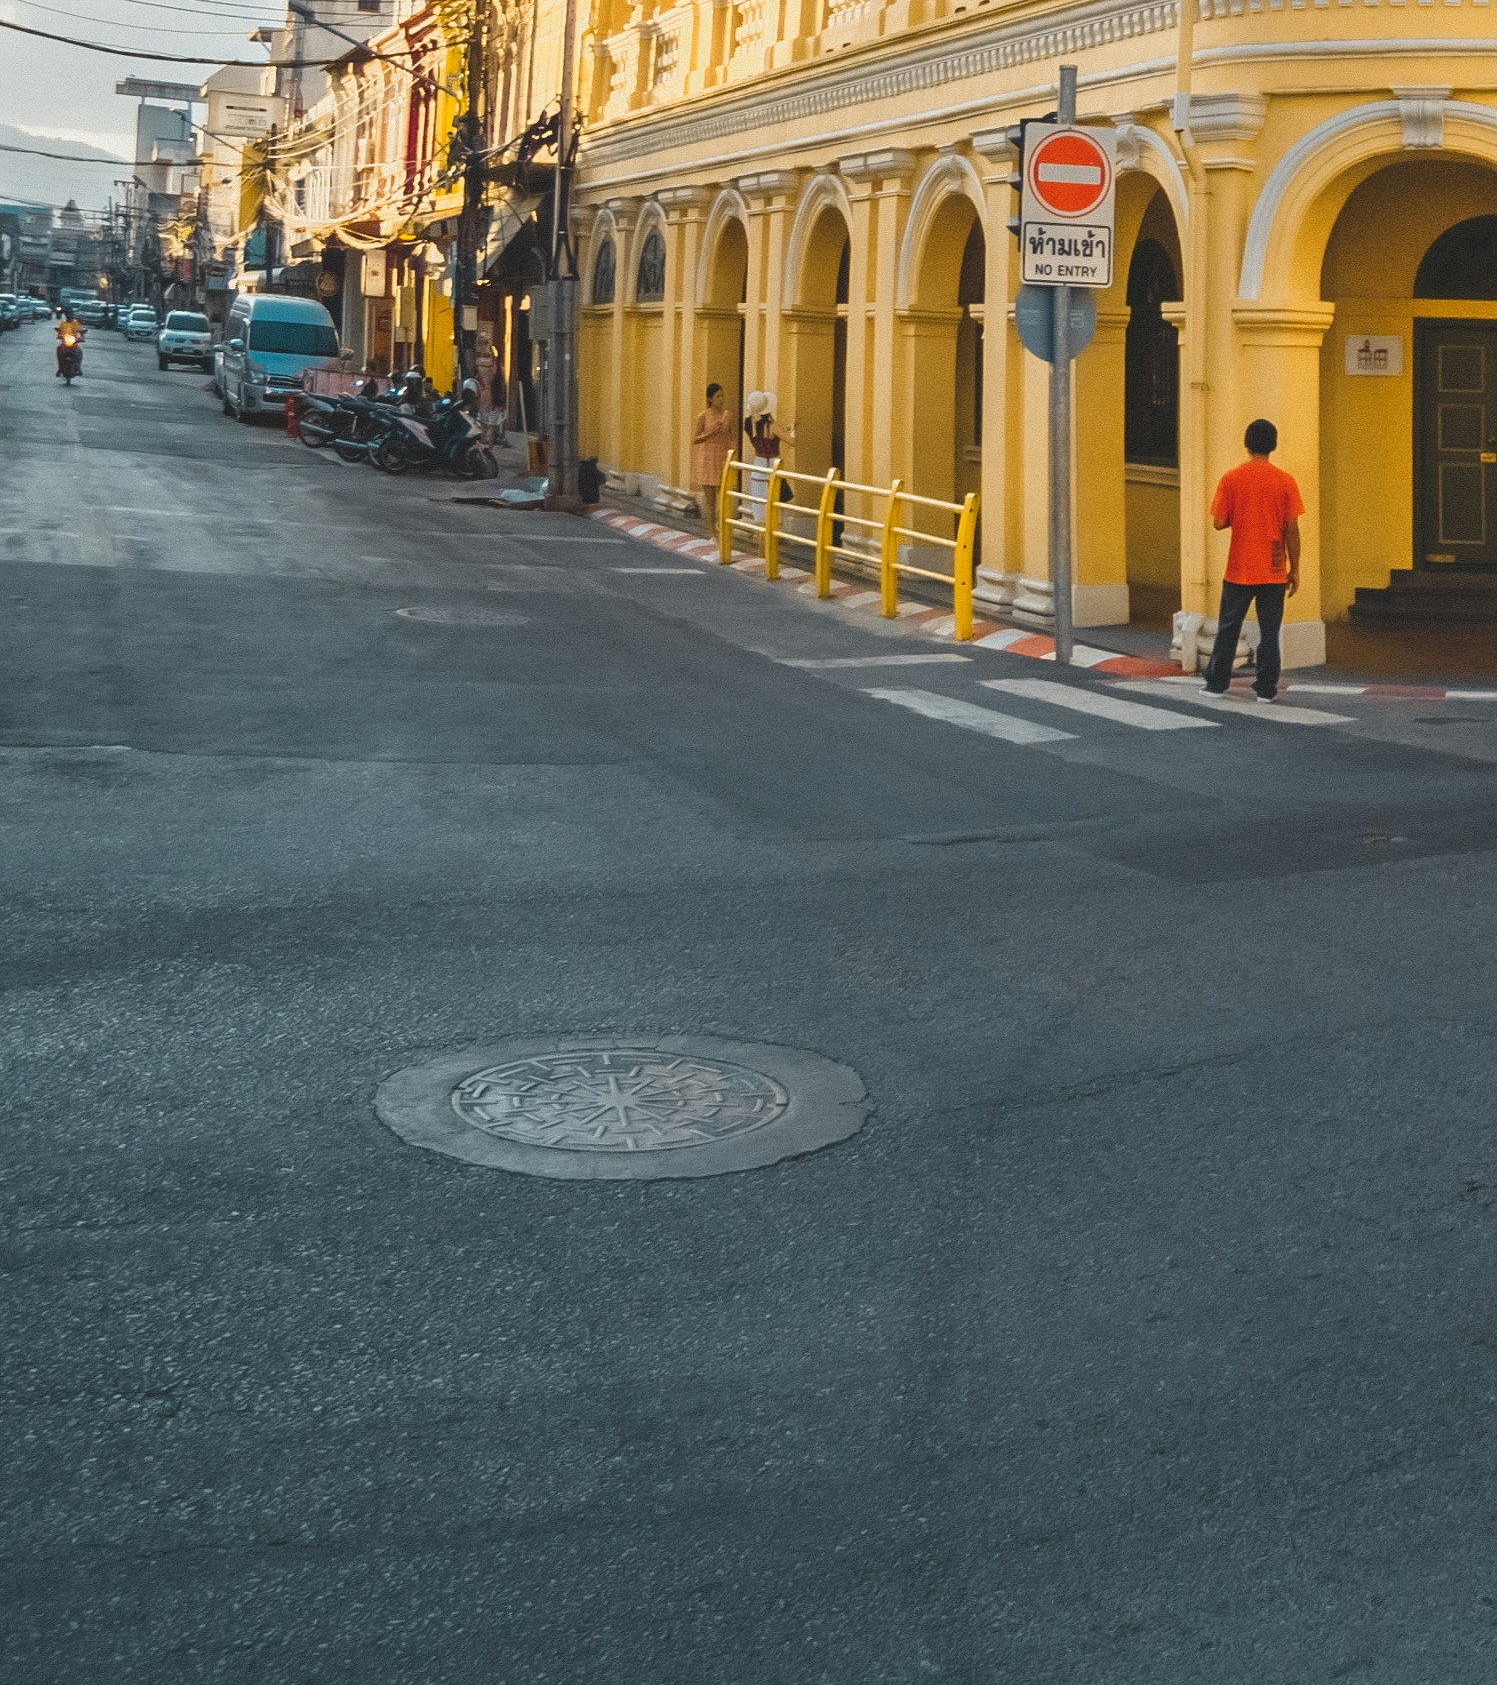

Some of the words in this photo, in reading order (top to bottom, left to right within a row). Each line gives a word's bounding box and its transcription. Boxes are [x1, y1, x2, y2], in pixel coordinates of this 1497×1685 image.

[1029, 227, 1105, 258] ห้ามเข้า
[1034, 263, 1053, 277] NO
[1057, 264, 1098, 278] ENTRY
